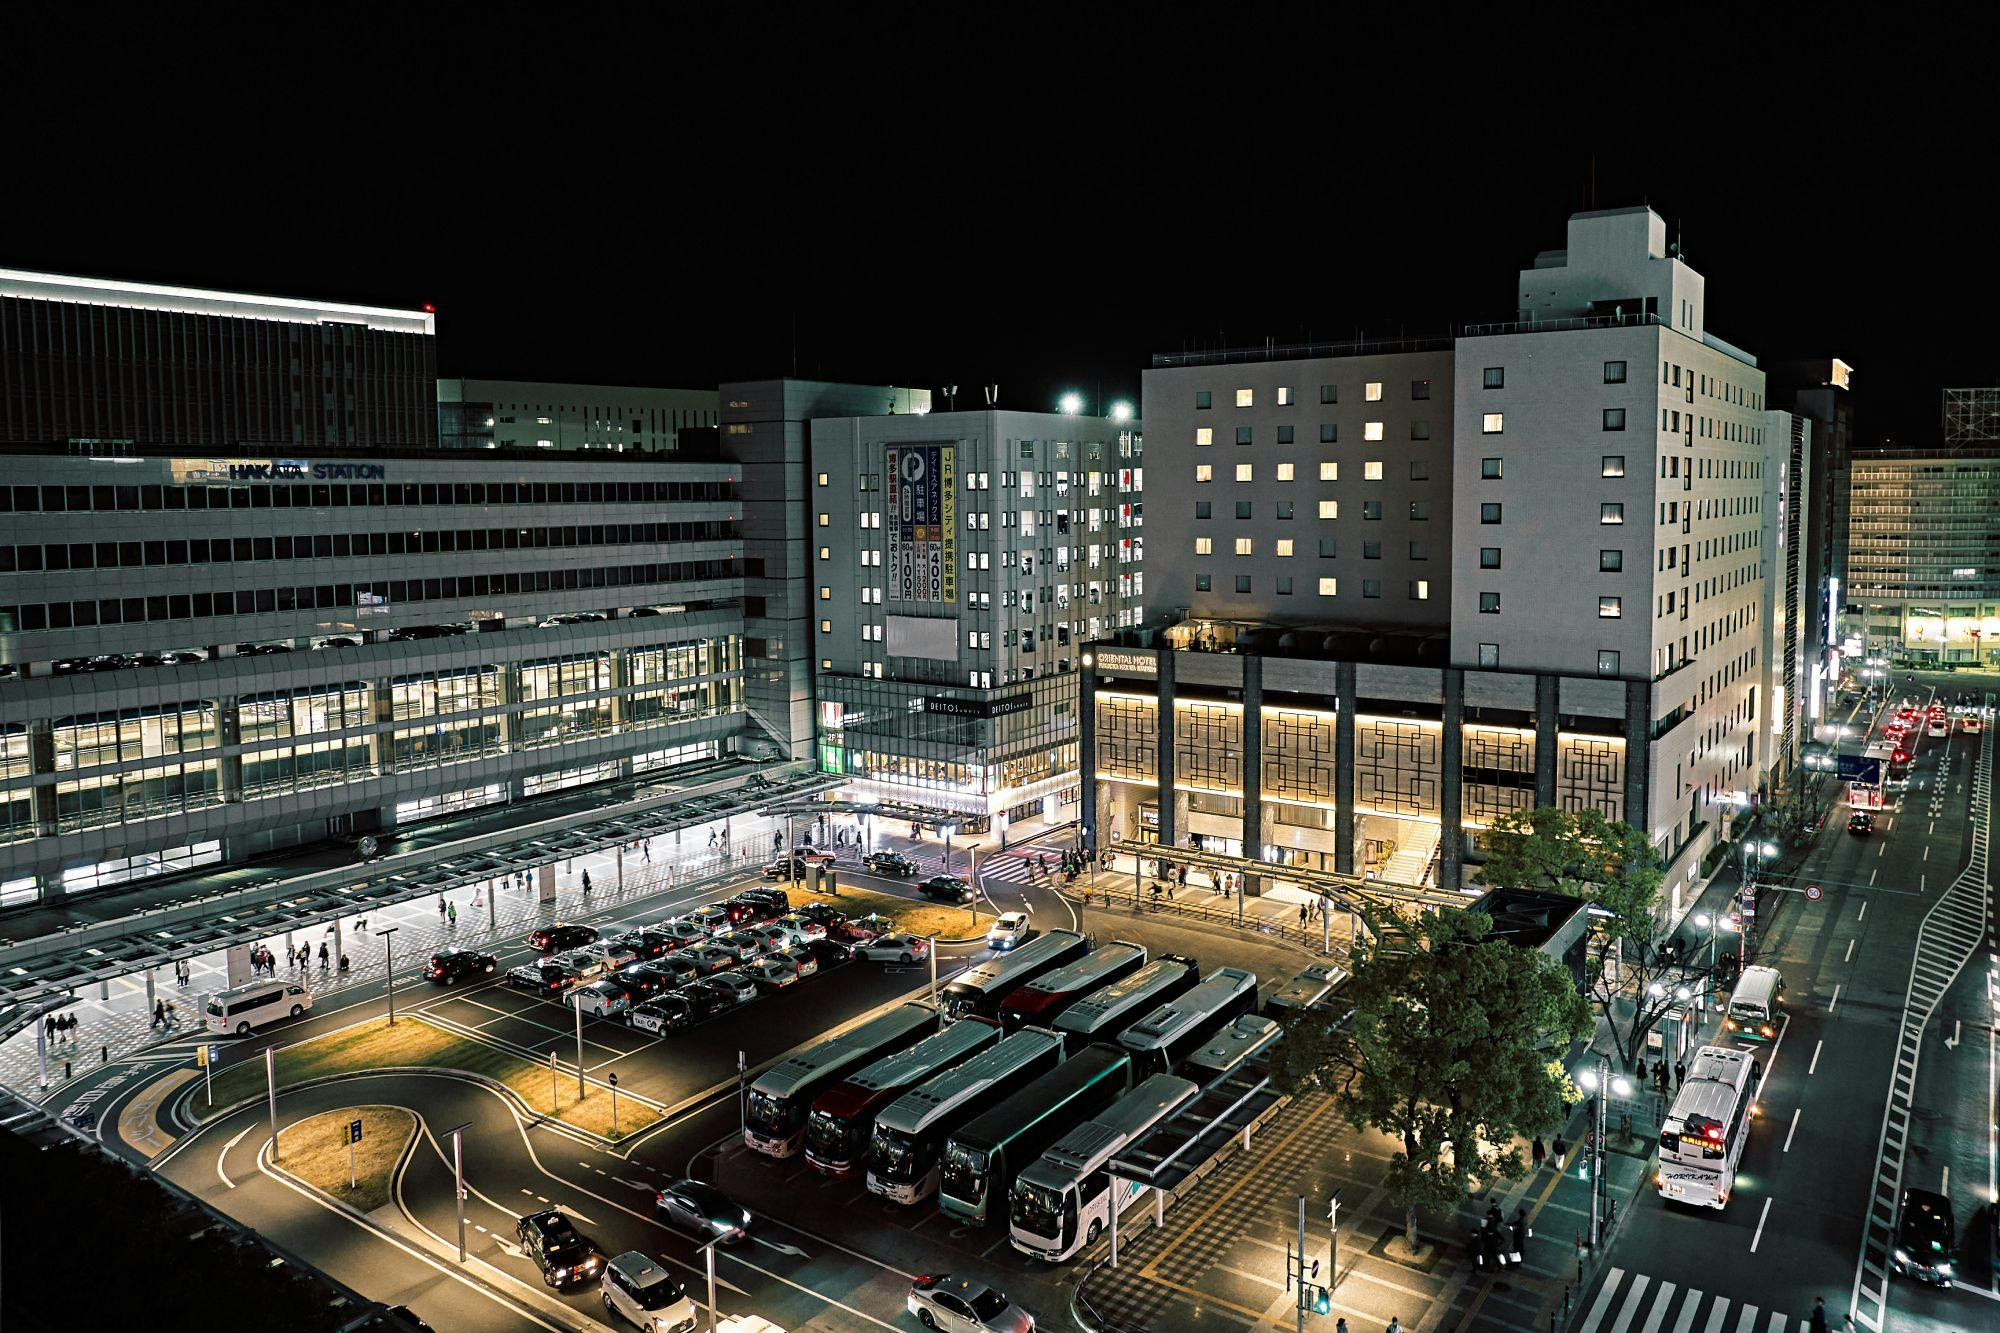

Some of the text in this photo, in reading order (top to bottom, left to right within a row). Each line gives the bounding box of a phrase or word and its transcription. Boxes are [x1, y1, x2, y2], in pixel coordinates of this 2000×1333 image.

[230, 464, 305, 479] HAKATA
[313, 463, 385, 479] STATION
[930, 451, 938, 522] デイトスアネックス
[915, 484, 925, 521] 駐車場
[944, 451, 954, 599] JR博多シティ提携駐車場
[931, 552, 940, 600] 400円
[1098, 653, 1157, 666] ORIENTAL HOTEL
[930, 702, 958, 712] DEITOS
[991, 703, 1013, 714] DEITOS
[1808, 889, 1819, 897] 50
[1665, 1172, 1719, 1182] HORIKAWA
